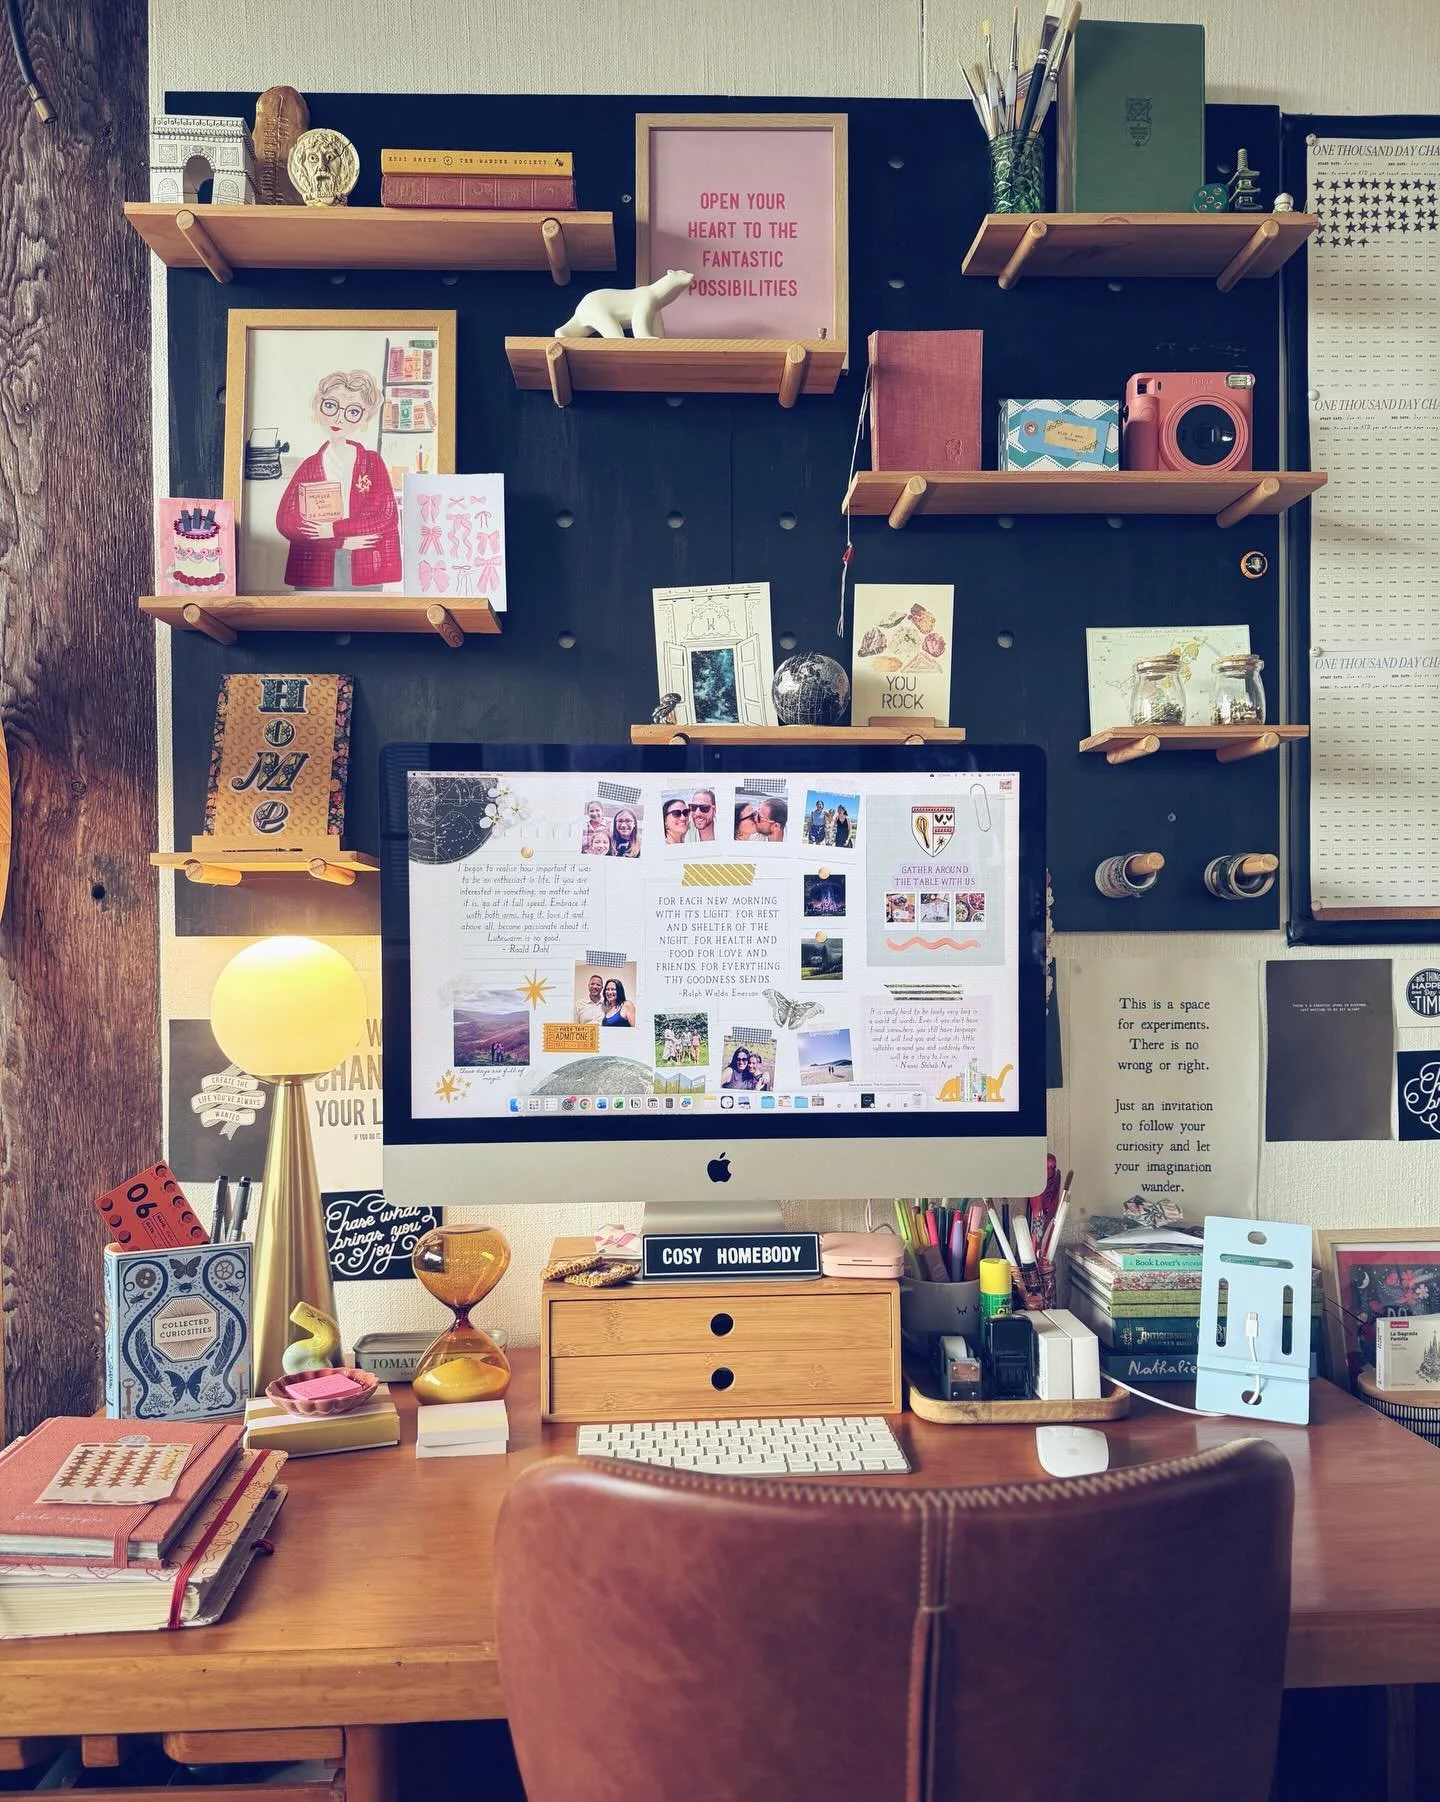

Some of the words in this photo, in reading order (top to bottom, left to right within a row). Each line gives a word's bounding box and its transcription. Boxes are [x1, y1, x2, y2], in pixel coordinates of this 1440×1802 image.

[1312, 145, 1336, 156] ONE
[1337, 145, 1393, 156] THOUSAND
[1394, 145, 1418, 156] DAY
[700, 192, 739, 209] OPEN
[747, 192, 785, 209] YOUR
[688, 222, 736, 238] HEART
[743, 222, 761, 238] TO
[768, 222, 798, 238] THE
[703, 251, 783, 268] FANTASTIC
[688, 279, 798, 296] POSSIBILITIES
[1314, 400, 1337, 411] ONE
[1339, 399, 1396, 411] THOUSAND
[1398, 399, 1421, 410] DAY
[1316, 658, 1337, 670] ONE
[1340, 657, 1398, 670] THOUSAND
[1399, 657, 1422, 669] DAY
[885, 675, 917, 692] YOU
[881, 694, 924, 710] ROCK
[458, 863, 462, 872] I
[464, 864, 483, 873] began
[486, 864, 494, 872] to
[520, 864, 534, 872] how
[536, 864, 568, 873] important
[570, 864, 576, 872] it
[902, 866, 933, 874] GATHER
[895, 878, 911, 886] THE
[914, 878, 939, 886] TABLE
[659, 896, 676, 905] FOR
[680, 896, 703, 905] EACH
[707, 896, 728, 905] NEW
[732, 896, 778, 905] MORNING
[656, 910, 680, 918] WITH
[736, 910, 753, 918] FOR
[757, 910, 780, 918] REST
[666, 923, 687, 932] AND
[691, 923, 732, 932] SHELTER
[735, 923, 746, 932] OF
[750, 923, 769, 932] THE
[695, 936, 712, 945] FOR
[716, 936, 752, 945] HEALTH
[756, 936, 777, 945] AND
[509, 944, 529, 953] Roald
[533, 944, 550, 953] Dahl
[669, 949, 694, 958] FOOD
[698, 949, 715, 958] FOR
[719, 949, 742, 958] LOVE
[746, 949, 767, 958] AND
[701, 962, 718, 971] FOR
[722, 962, 780, 971] EVERYTHING
[664, 976, 683, 984] THY
[687, 976, 736, 984] GOODNESS
[705, 989, 728, 997] Waldo
[732, 988, 758, 997] Emerson
[1119, 998, 1146, 1009] This
[1153, 998, 1161, 1009] is
[1167, 1001, 1174, 1009] a
[1180, 1001, 1210, 1013] space
[1118, 1018, 1134, 1030] for
[1141, 1019, 1209, 1033] experiments.
[556, 1032, 574, 1040] ADMIT
[576, 1032, 588, 1040] ONE
[1129, 1038, 1164, 1050] There
[1171, 1039, 1179, 1050] is
[1185, 1041, 1199, 1050] no
[1118, 1061, 1152, 1073] wrong
[1159, 1061, 1171, 1070] or
[1178, 1059, 1209, 1073] right.
[212, 1077, 235, 1085] CREATE
[198, 1095, 211, 1104] LIFE
[237, 1098, 260, 1106] ALWAYS
[1114, 1099, 1135, 1114] Just
[1141, 1102, 1154, 1110] an
[1161, 1100, 1213, 1111] invitation
[215, 1111, 240, 1121] WANTED
[315, 1099, 366, 1127] YOUR
[1122, 1123, 1133, 1131] to
[1139, 1120, 1174, 1131] follow
[1180, 1123, 1206, 1135] your
[1116, 1141, 1164, 1155] curiosity
[1170, 1140, 1190, 1152] and
[1196, 1140, 1210, 1152] let
[1115, 1163, 1140, 1174] your
[1147, 1162, 1212, 1175] imagination
[1141, 1181, 1185, 1192] wander.
[127, 1183, 158, 1218] 06
[327, 1200, 376, 1233] Chase
[380, 1207, 420, 1222] what
[146, 1222, 155, 1234] DATE
[391, 1221, 421, 1242] you
[662, 1248, 702, 1265] COSY
[717, 1246, 801, 1265] HOMEBODY
[162, 1318, 209, 1329] COLLECTED
[160, 1327, 212, 1338] CURIOSITIES
[1128, 1360, 1198, 1376] Nathalie
